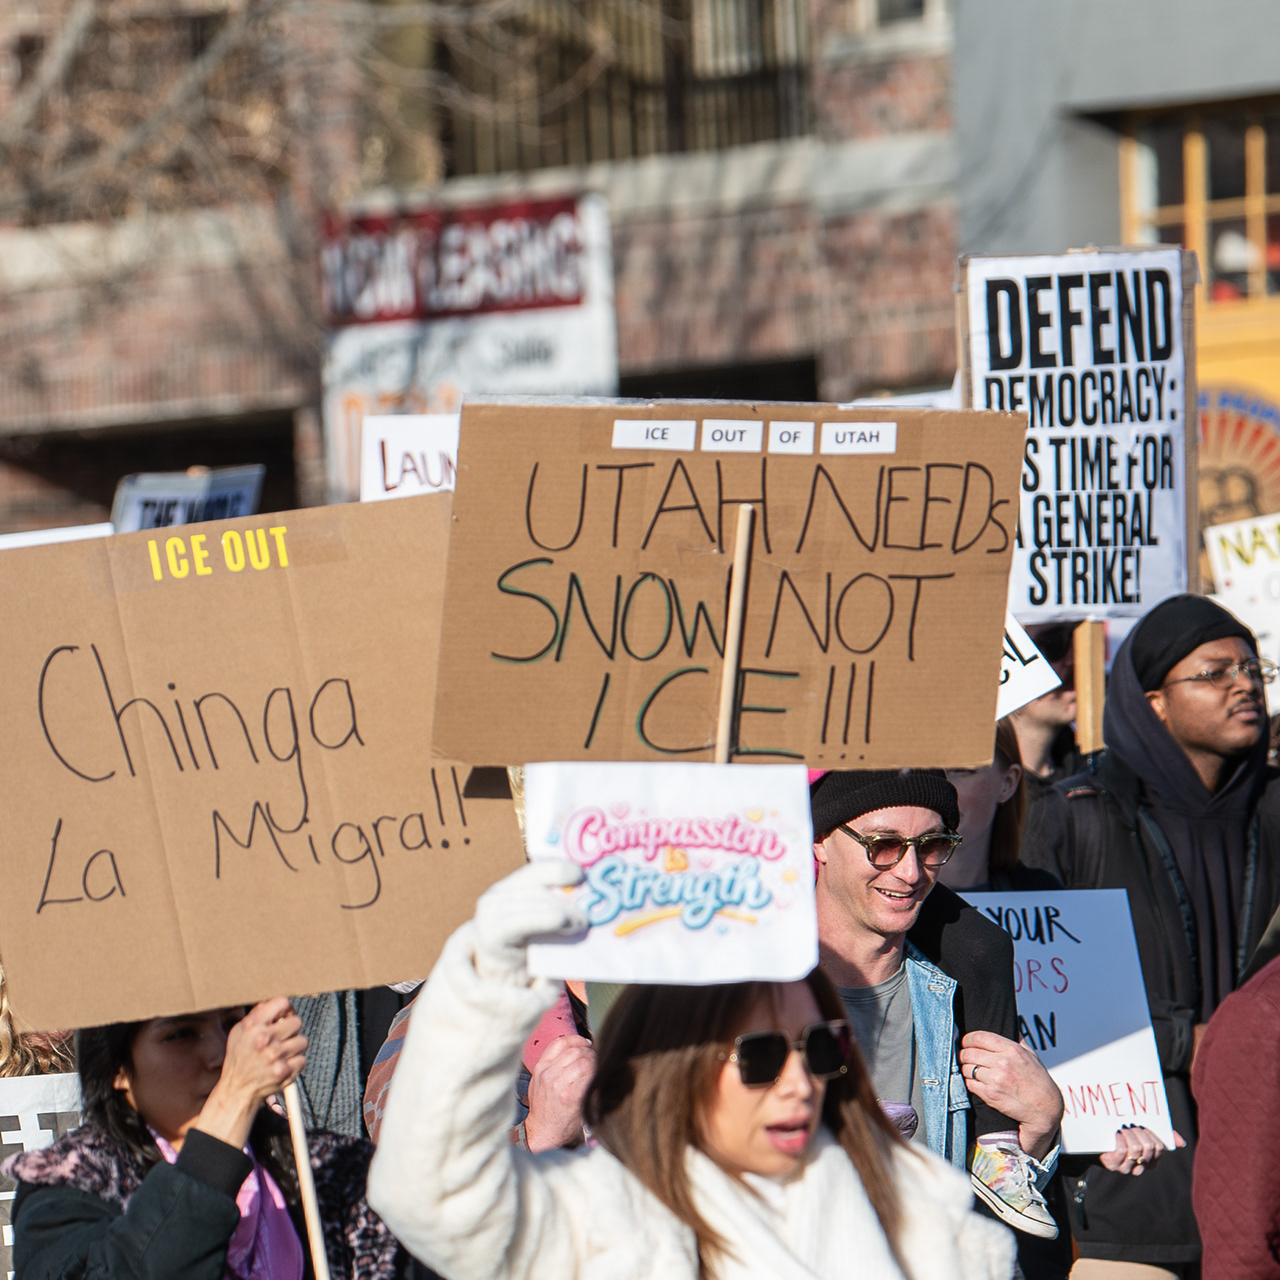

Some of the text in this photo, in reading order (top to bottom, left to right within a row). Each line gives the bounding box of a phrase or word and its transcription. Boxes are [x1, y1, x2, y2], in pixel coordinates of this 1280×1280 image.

[985, 268, 1173, 371] DEFEND
[985, 365, 1177, 430] DEMOCRACY:
[645, 427, 881, 445] ICE OUT OF UTAH
[1048, 436, 1119, 492] TIME
[1128, 434, 1175, 491] FOR
[526, 456, 772, 555] UTAH
[1032, 490, 1160, 550] GENERAL
[148, 525, 290, 581] ICE OUT
[1028, 547, 1144, 607] STRIKE!
[491, 557, 736, 663] SNOW
[765, 569, 956, 662] NOT
[36, 643, 365, 835] Chinga
[36, 766, 472, 914] La Migra!!
[576, 855, 773, 931] Strength
